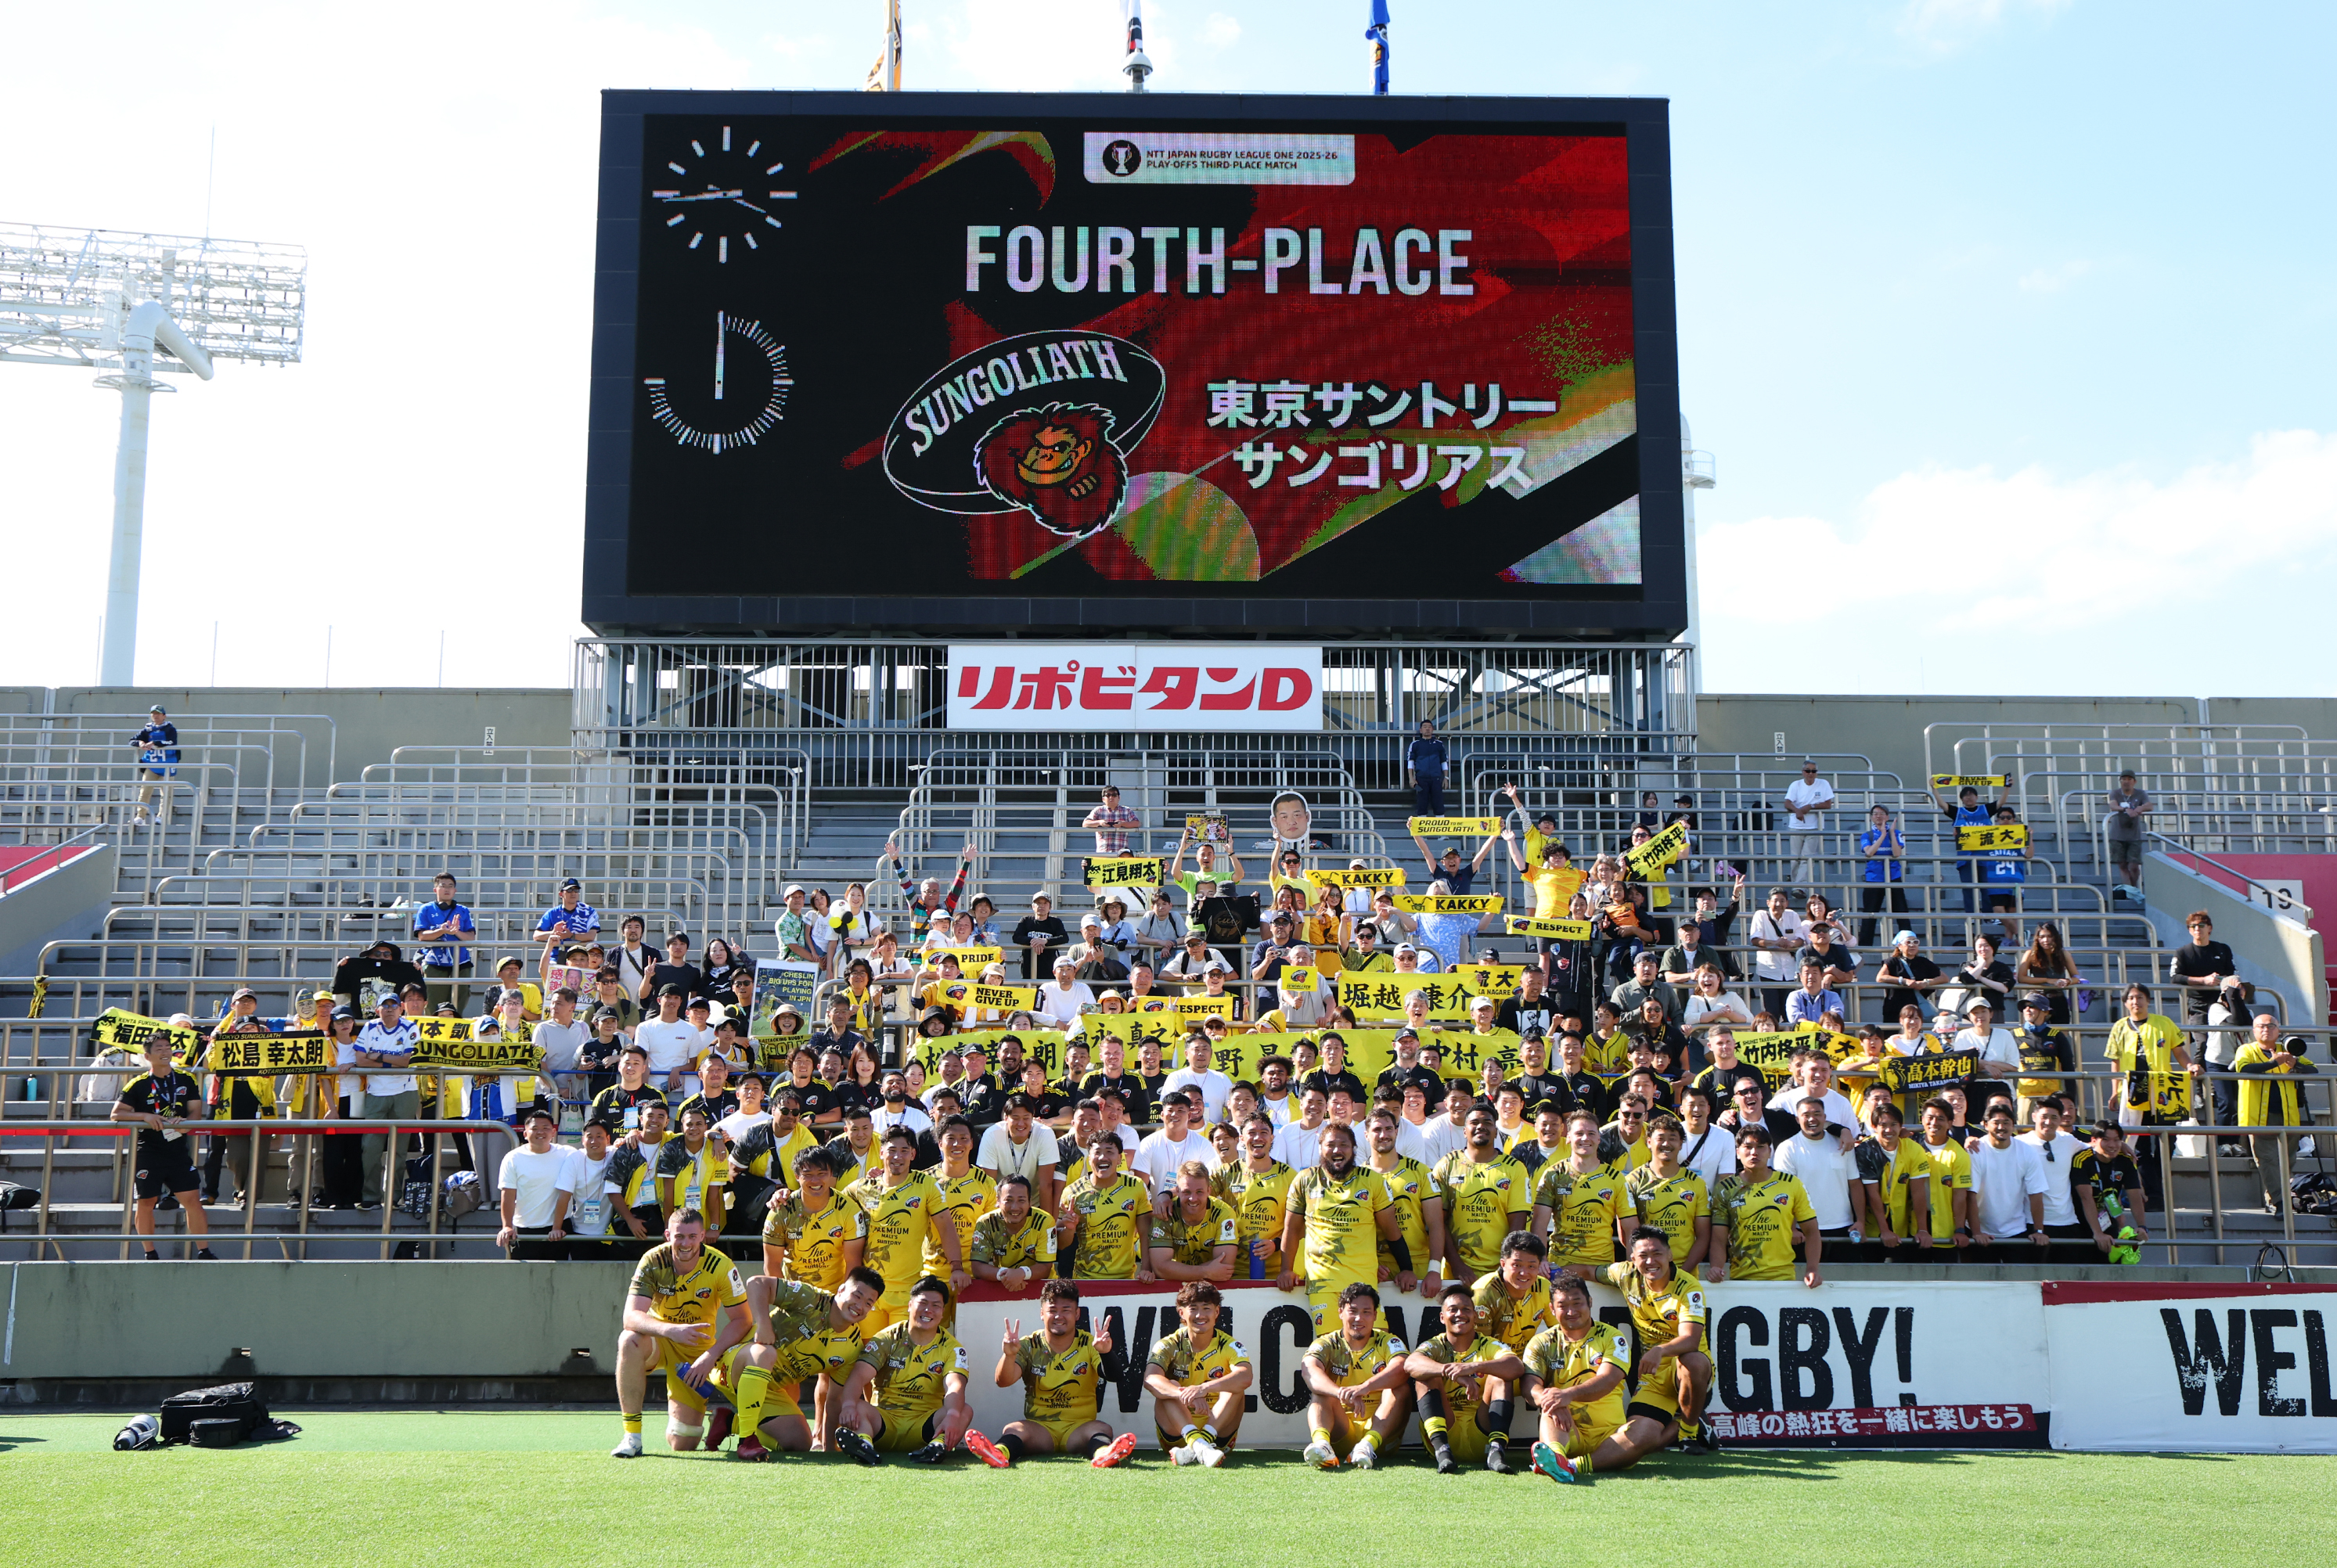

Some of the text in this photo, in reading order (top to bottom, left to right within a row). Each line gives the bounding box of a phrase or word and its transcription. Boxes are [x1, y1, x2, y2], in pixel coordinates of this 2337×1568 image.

[1147, 150, 1338, 160] NTT JAPAN RUGBY LEAGUE ONE 2025-26
[1147, 160, 1298, 170] PLAY-OFFS THIRD-PLACE MATCH
[965, 224, 1475, 297] FOURTH-PLACE
[904, 340, 1129, 459] SUNGOLIATH
[1206, 379, 1557, 430] 東京サントリー
[1233, 439, 1535, 491] サンゴリアス
[957, 659, 1313, 710] リポビタンD
[1101, 861, 1157, 885] 江見翔太
[1341, 872, 1394, 885] KAKKY
[1435, 898, 1491, 910] KAKKY
[1535, 922, 1584, 933] RESPECT
[960, 953, 995, 964] PRIDE
[783, 971, 814, 980] CHESLIN
[798, 980, 813, 988] FOR
[782, 987, 812, 996] PLAYING
[975, 987, 1014, 999] NEVER
[1342, 982, 1403, 1011] 堀越
[974, 995, 1020, 1007] GIVE UP
[1177, 1005, 1225, 1014] ESPECT
[239, 1032, 283, 1041] SUNGOLIATH
[221, 1038, 325, 1069] 松島 幸太朗
[284, 1066, 325, 1074] MATSUSHIMA
[1908, 1081, 1929, 1090] MIKIYA
[1460, 1204, 1497, 1214] PREMIUM
[1240, 1213, 1277, 1222] PREMIUM
[1566, 1214, 1602, 1225] PREMIUM
[1650, 1219, 1687, 1228] PREMIUM
[872, 1227, 909, 1235] PREMIUM
[1090, 1230, 1129, 1239] PREMIUM
[798, 1253, 834, 1264] PREMIUM
[1599, 1304, 1916, 1413] RGBY!
[1711, 1406, 2026, 1438] 高峰の熱狂を一緒に楽しもう
